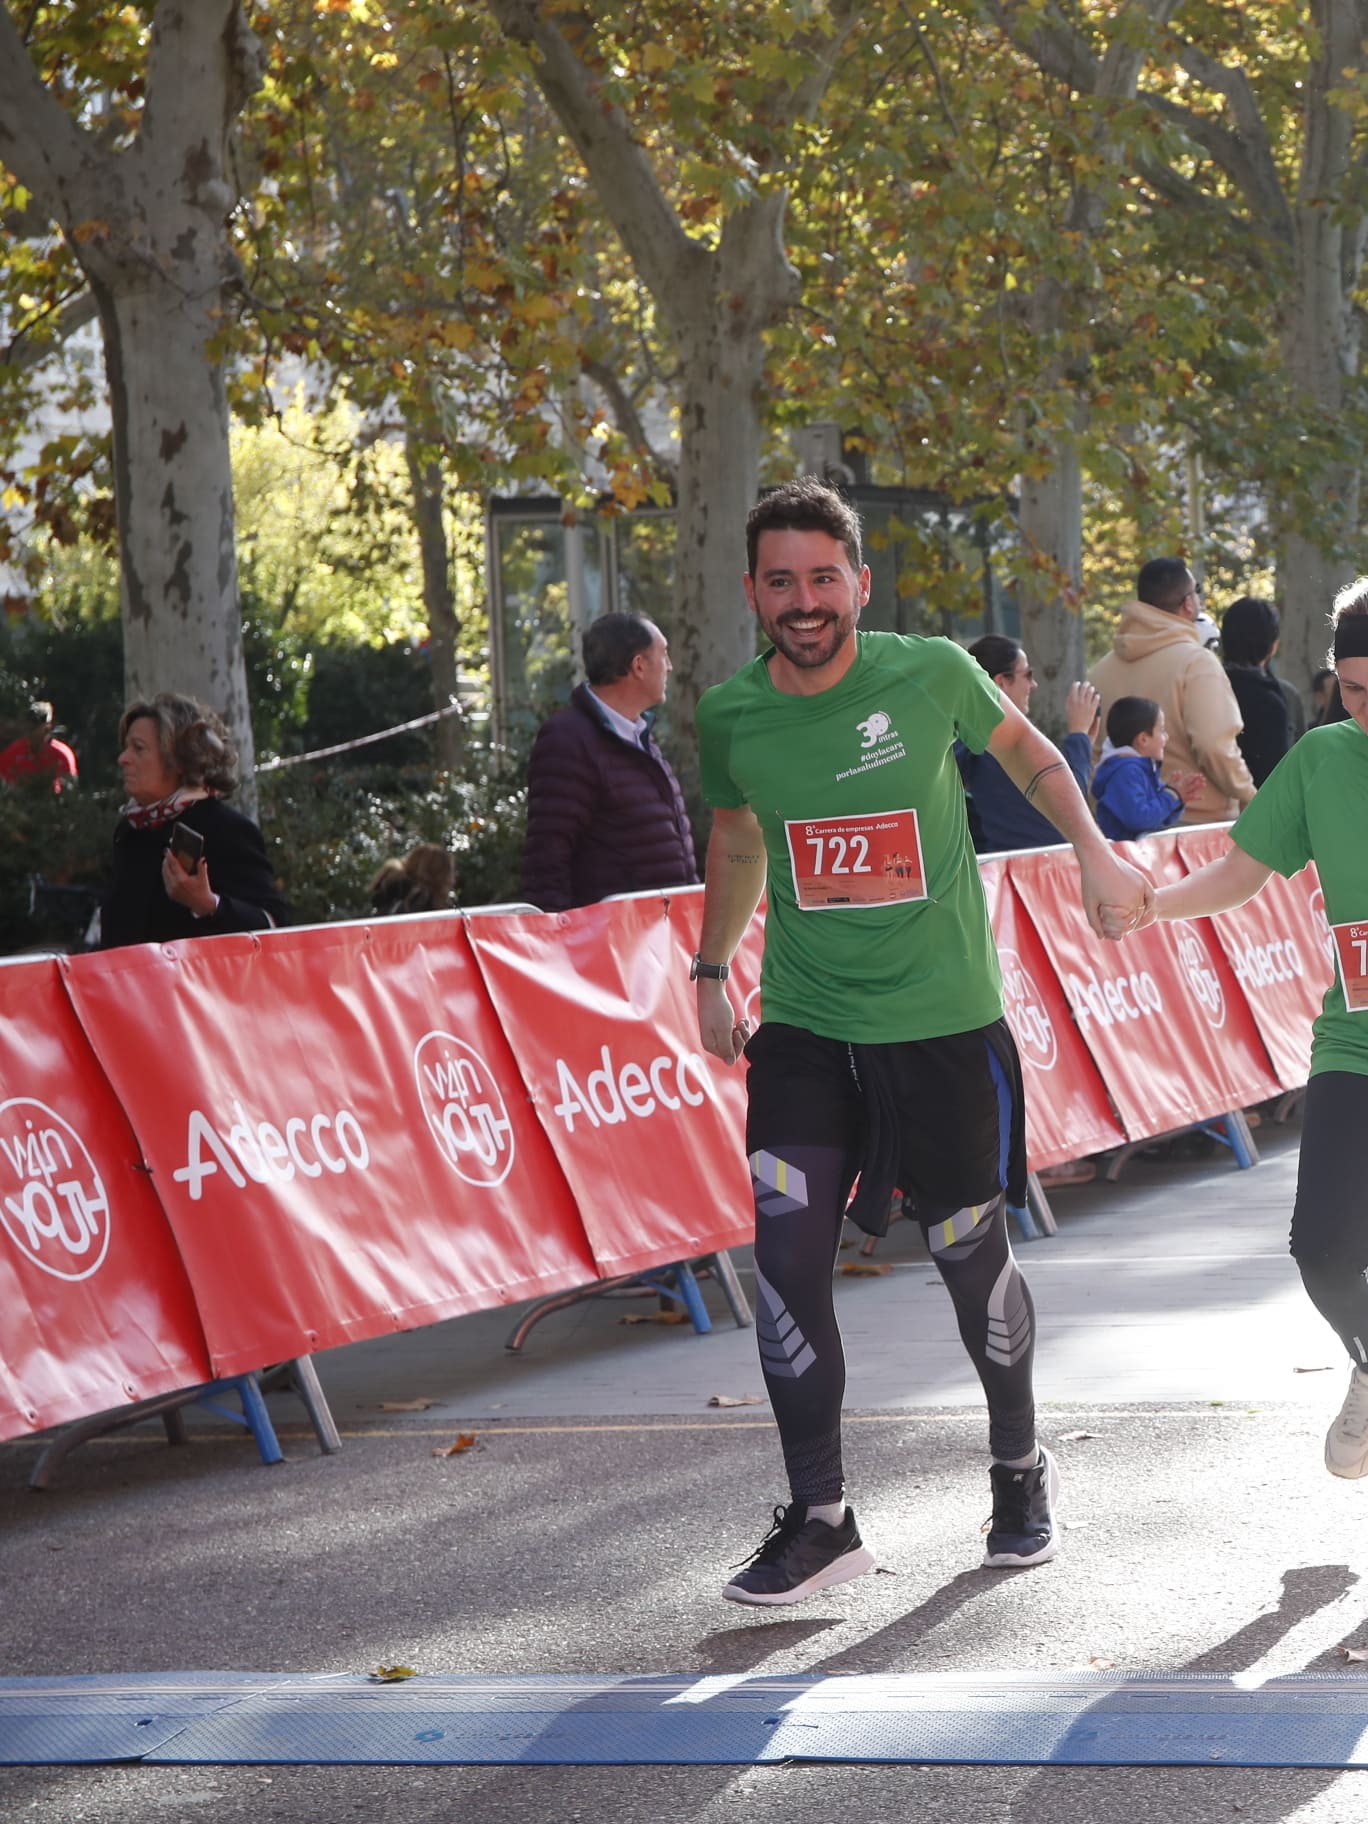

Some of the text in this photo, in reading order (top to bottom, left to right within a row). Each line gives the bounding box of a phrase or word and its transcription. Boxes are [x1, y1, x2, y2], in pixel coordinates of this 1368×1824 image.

[861, 742, 903, 762] #doylacara
[878, 730, 898, 743] intras
[835, 749, 906, 781] porlasaludmental
[815, 827, 837, 835] Carrera
[846, 825, 874, 834] empresas
[806, 835, 872, 875] 722
[1235, 935, 1304, 989] Adecco
[1069, 966, 1162, 1031] Adecco
[173, 1100, 369, 1200] Adecco
